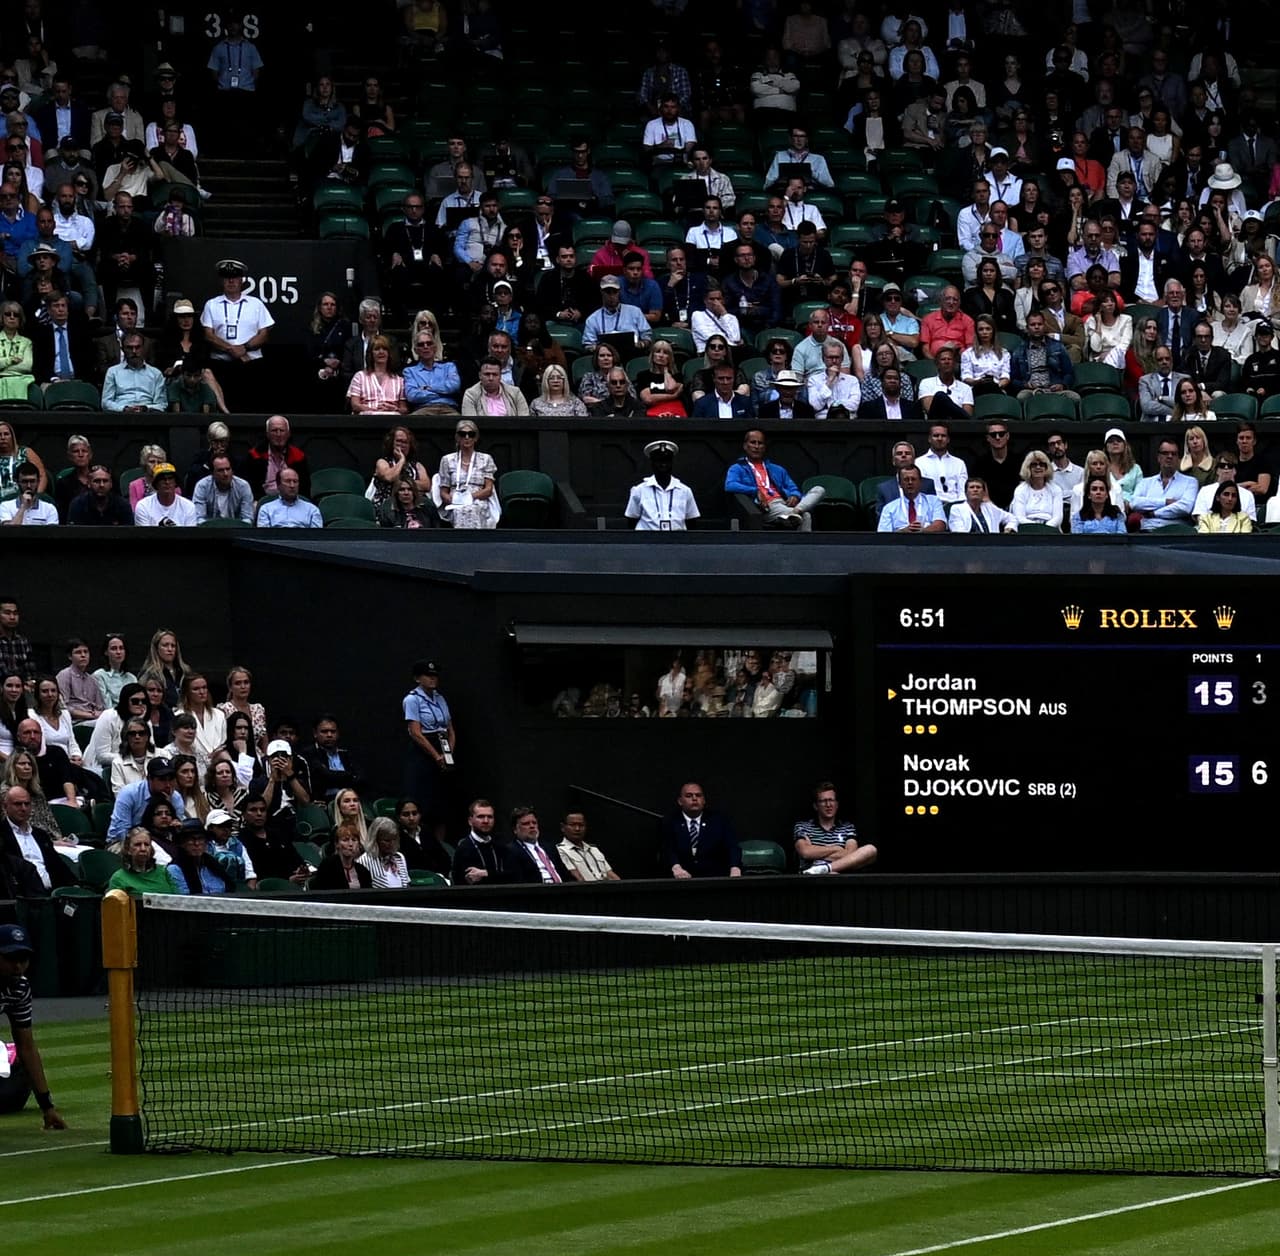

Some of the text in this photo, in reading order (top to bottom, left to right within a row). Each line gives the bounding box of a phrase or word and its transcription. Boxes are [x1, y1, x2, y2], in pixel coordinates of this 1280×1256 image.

[204, 13, 260, 39] 38
[899, 608, 945, 628] 6:51
[1099, 608, 1198, 630] ROLEX
[1192, 653, 1234, 664] POINTS
[1255, 653, 1262, 664] 1
[901, 672, 977, 691] Jordan
[1193, 680, 1235, 707] 15
[1252, 680, 1267, 705] 3
[902, 698, 1068, 716] THOMPSON AUS
[903, 753, 970, 772] Novak
[1194, 760, 1235, 786] 15
[1251, 760, 1268, 785] 6
[903, 778, 1077, 799] DJOKOVIC SRB (2)
